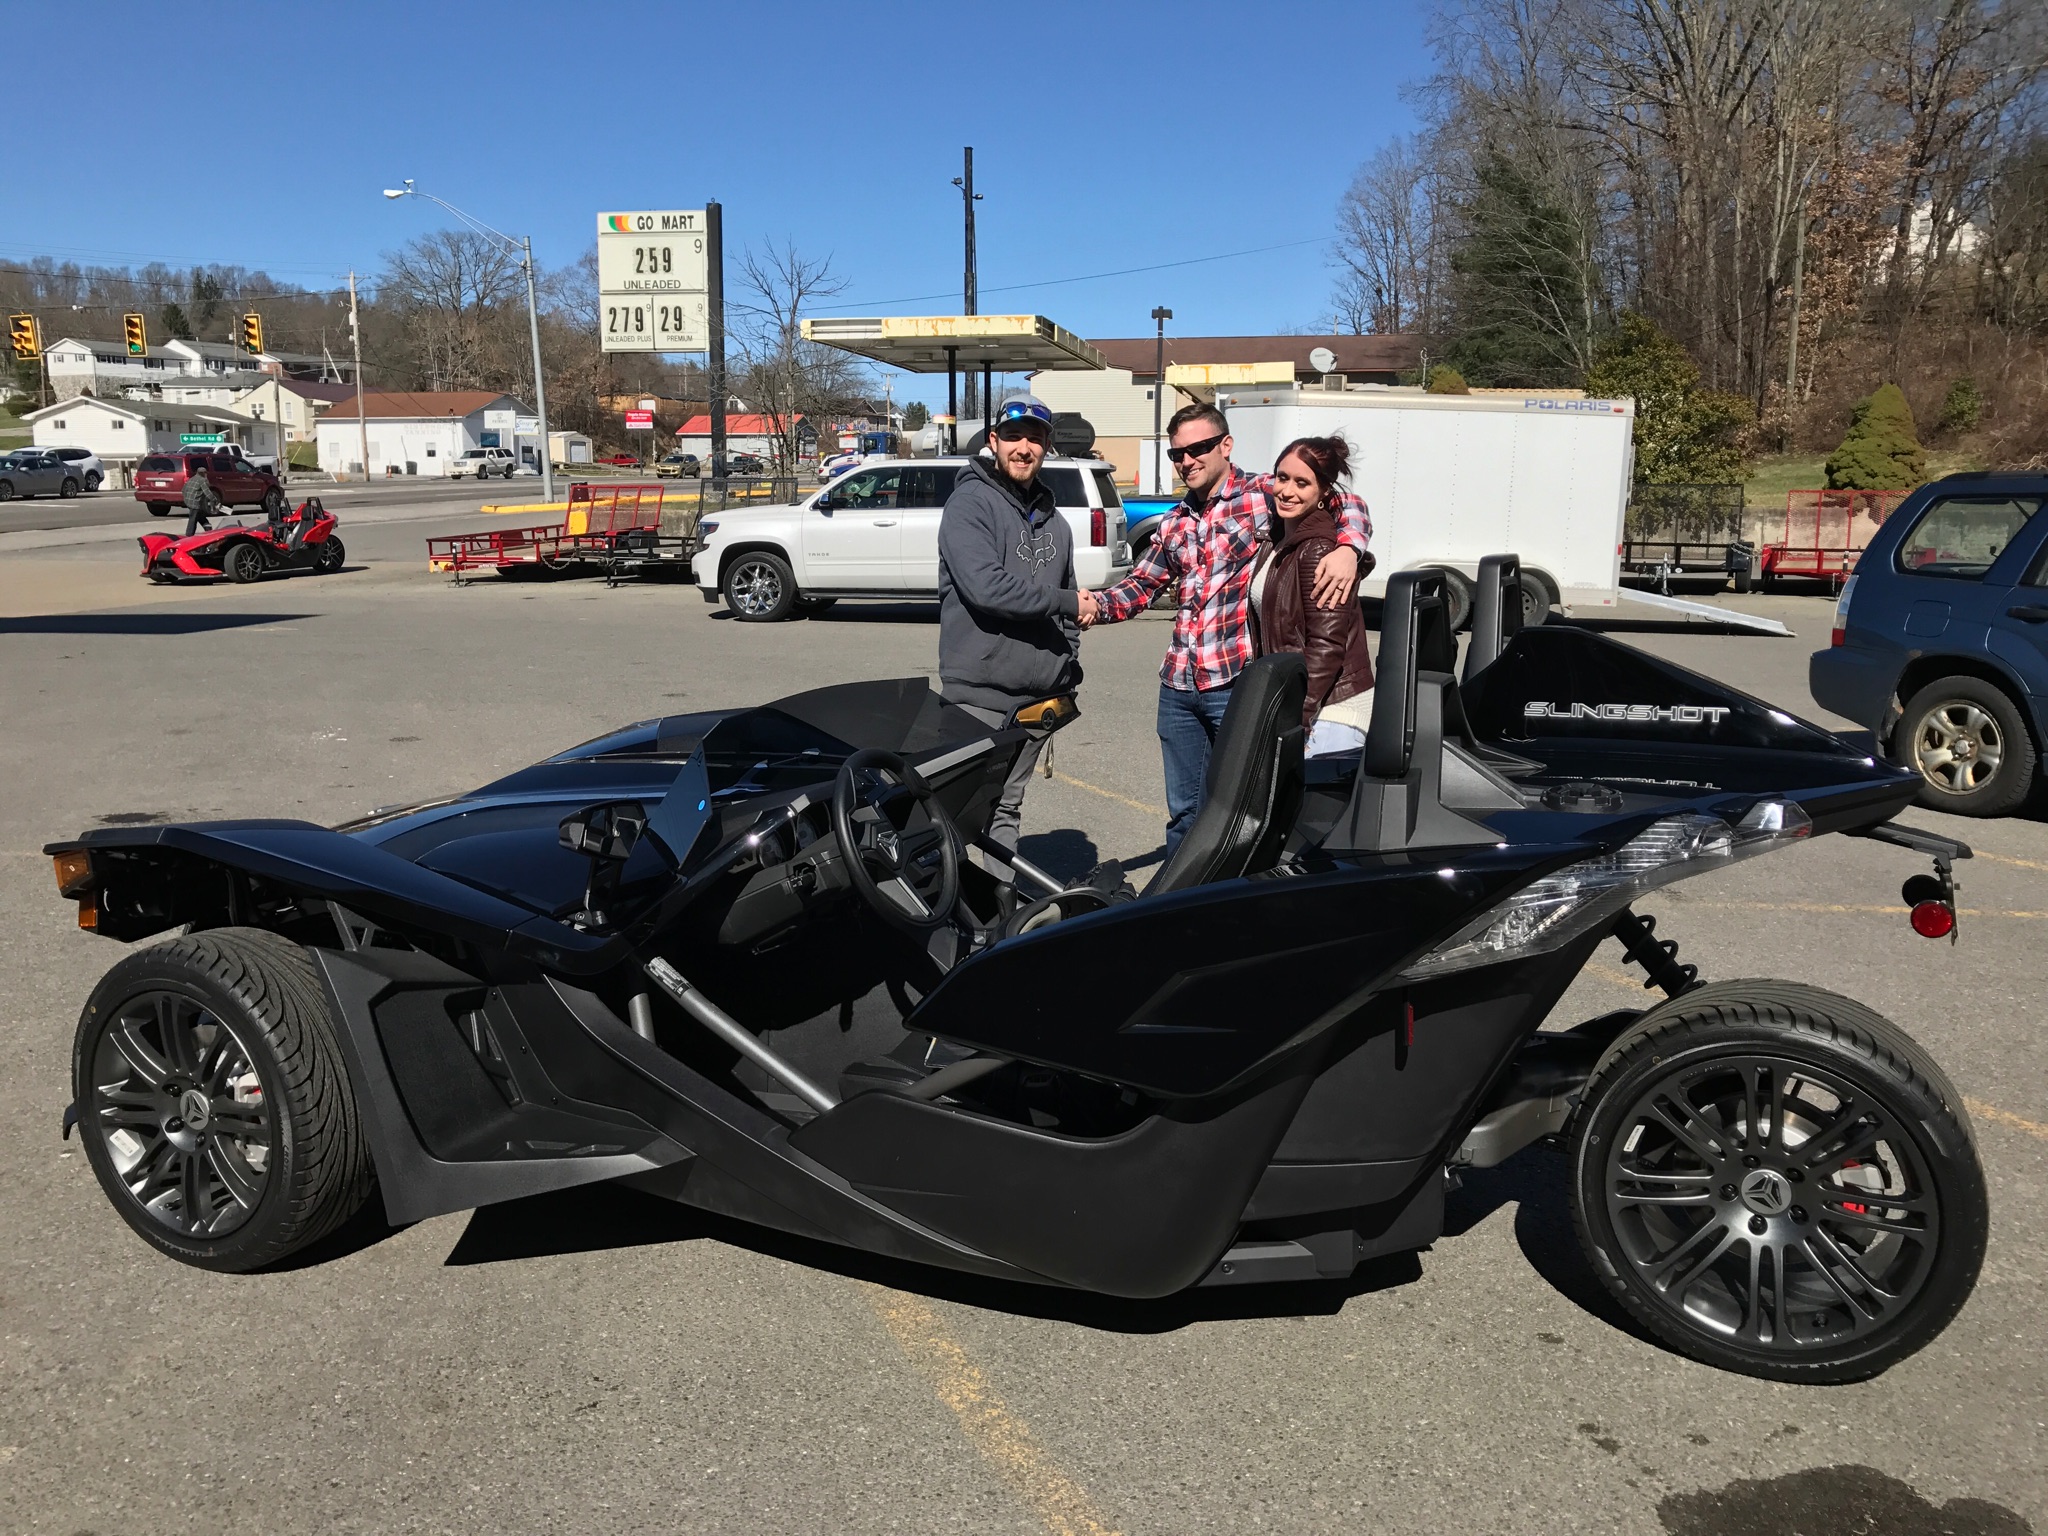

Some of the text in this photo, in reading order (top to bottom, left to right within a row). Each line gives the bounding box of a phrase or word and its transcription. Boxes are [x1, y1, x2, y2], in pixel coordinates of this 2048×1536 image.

[637, 215, 694, 230] GO MART
[635, 239, 702, 273] 259 9
[624, 280, 681, 289] UNLEADED
[609, 303, 651, 332] 279 9
[660, 306, 682, 332] 29
[1525, 399, 1611, 411] POLARIS
[1524, 701, 1731, 723] SLINGSHOT
